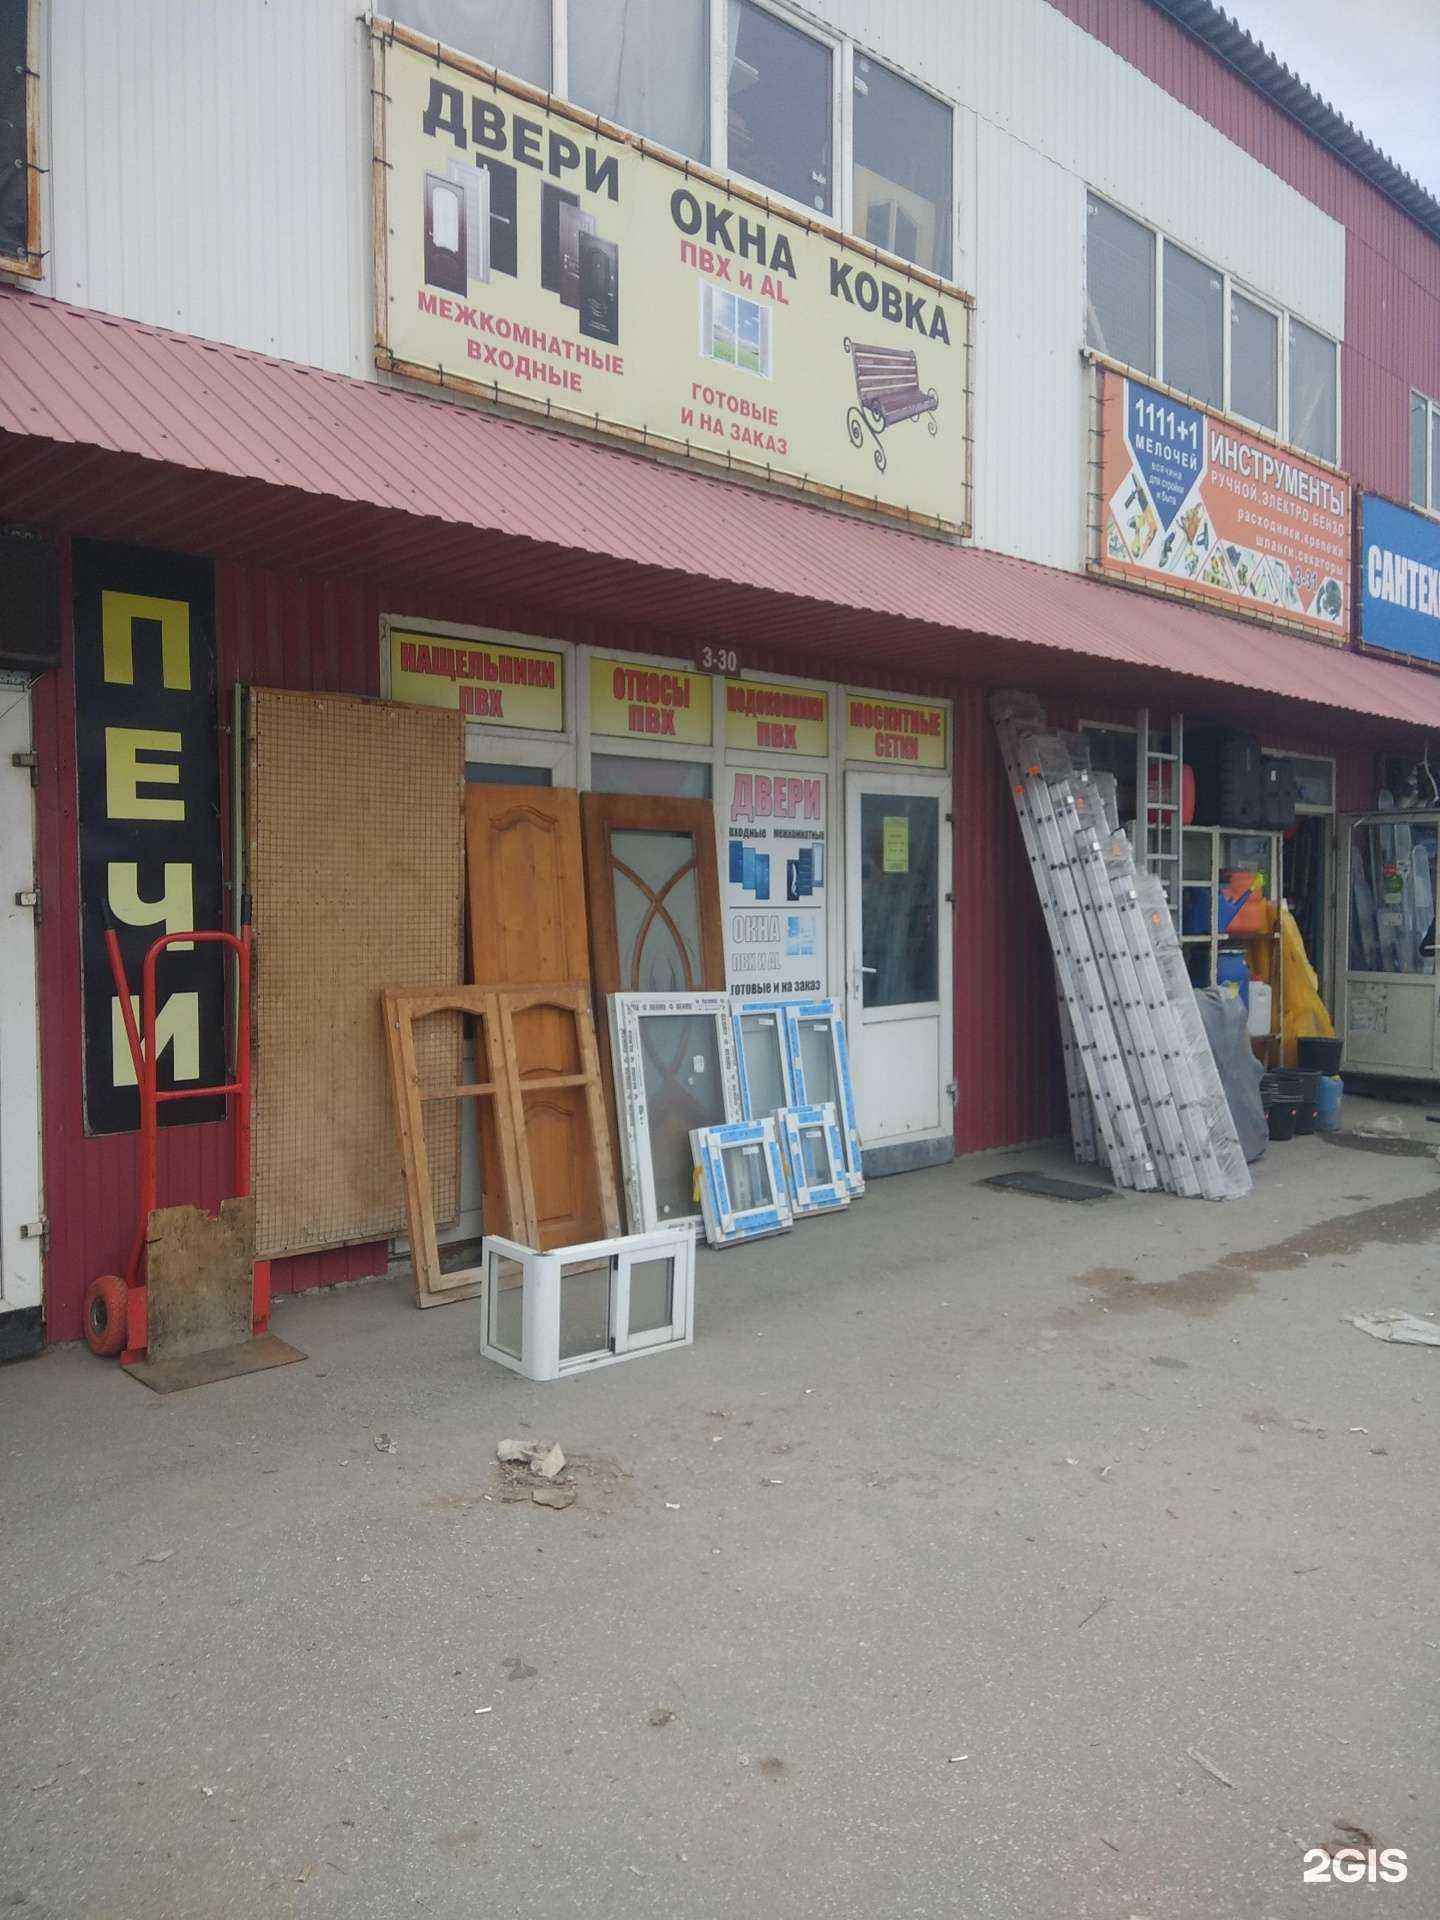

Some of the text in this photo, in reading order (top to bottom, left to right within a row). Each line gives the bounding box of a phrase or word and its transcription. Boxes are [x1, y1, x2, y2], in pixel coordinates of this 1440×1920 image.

[423, 78, 619, 202] ДВЕРИ
[670, 189, 797, 280] ОКНА
[679, 240, 731, 284] ПВХ
[761, 275, 790, 306] AL
[829, 257, 951, 346] КОВКА
[418, 291, 624, 376] МЕЖКОМНАТНЫЕ
[467, 339, 582, 392] ВХОДНЫЕ
[691, 382, 778, 427] ГОТОВЫЕ
[1136, 398, 1198, 450] 1111+1
[680, 407, 788, 456] И НА ЗАКАЗ
[1135, 434, 1198, 470] МЕЛОЧЕЙ
[1211, 431, 1345, 517] ИНСТРУМЕНТЫ
[1367, 544, 1440, 620] САНТЕХ
[401, 641, 555, 689] НАЩЕЛЬНИКИ
[702, 646, 737, 671] 3-30
[459, 685, 504, 718] ПВХ
[613, 667, 690, 709] ОТКОСЫ
[628, 704, 676, 736] ПВХ
[757, 721, 798, 749] ПВХ
[850, 702, 941, 737] МОСКИТНЫЕ
[874, 732, 919, 760] СЕТКИ
[731, 773, 821, 823] ДВЕРИ
[101, 590, 200, 1087] ПЕЧИ
[732, 914, 781, 944] ОКНА
